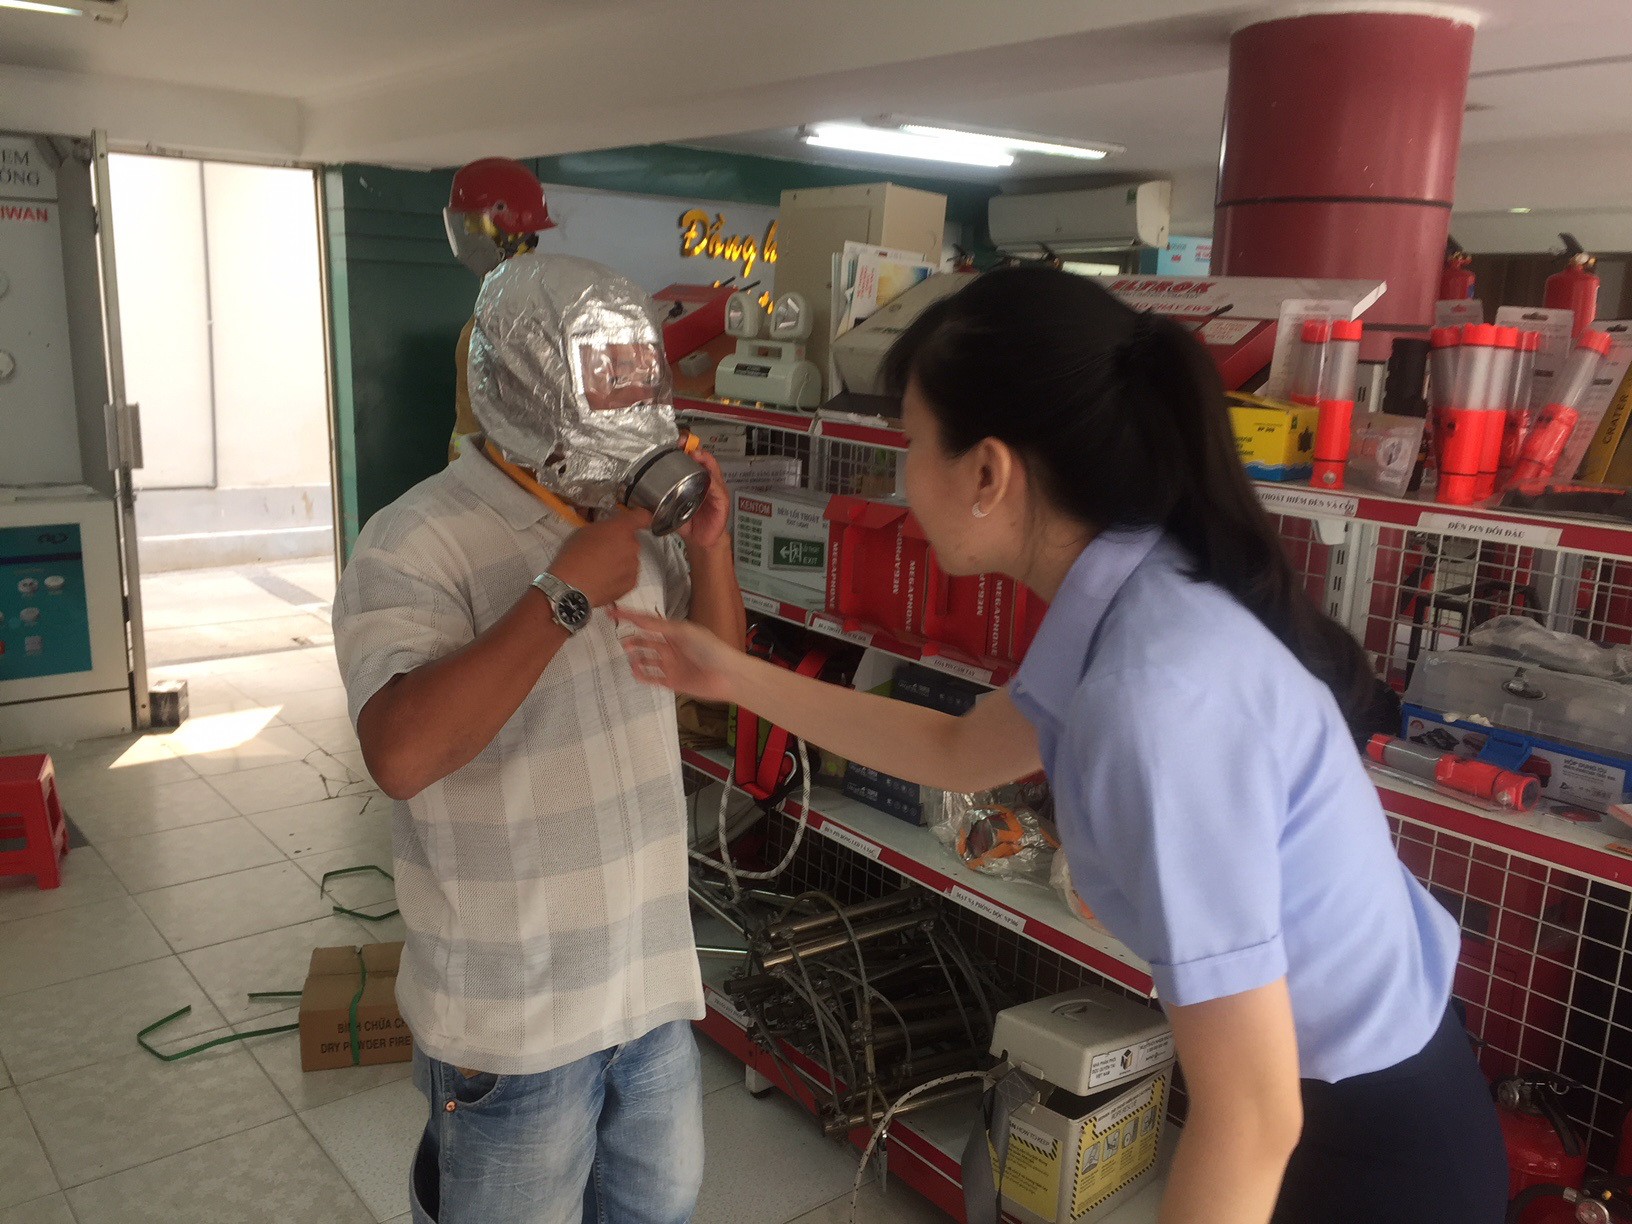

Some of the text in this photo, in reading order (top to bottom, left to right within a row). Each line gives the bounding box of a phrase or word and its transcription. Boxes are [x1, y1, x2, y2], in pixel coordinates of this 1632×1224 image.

[0, 205, 49, 222] IWAN
[762, 219, 780, 264] h
[1468, 524, 1484, 532] PIN
[337, 1020, 363, 1034] BÌH
[320, 1035, 411, 1054] DRY PWDER FIRE
